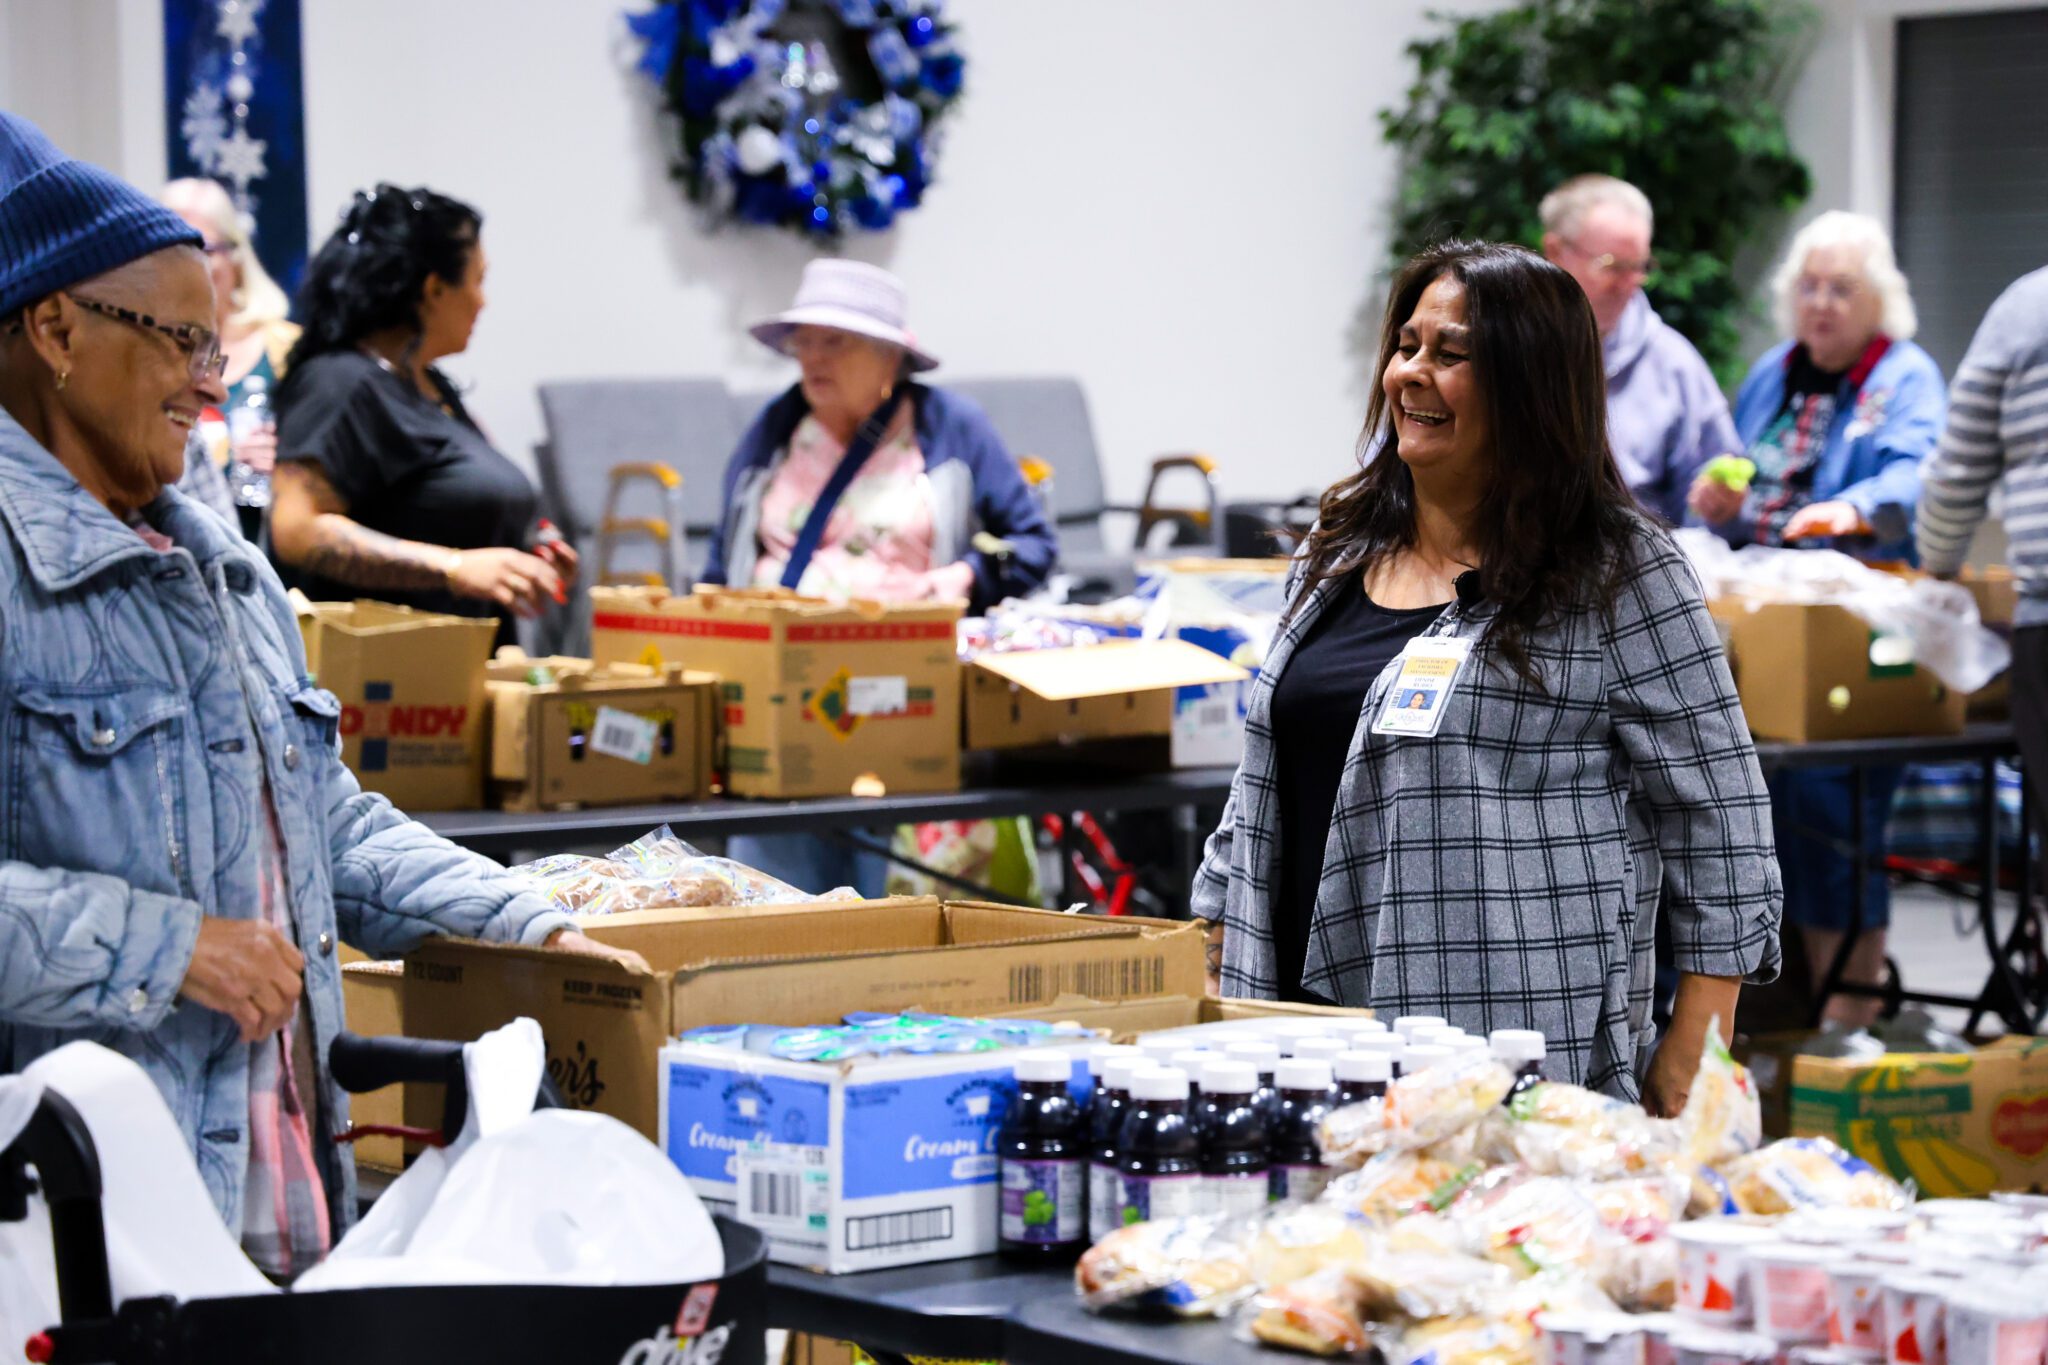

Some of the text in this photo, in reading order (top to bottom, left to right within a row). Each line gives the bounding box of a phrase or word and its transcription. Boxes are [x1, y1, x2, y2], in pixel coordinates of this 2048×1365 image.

[338, 704, 468, 736] DNDY
[427, 963, 463, 984] COUNT
[563, 978, 642, 999] KEEP FROZEN
[545, 1040, 605, 1106] er's
[689, 1121, 738, 1151] Crea
[903, 1134, 978, 1162] Cream
